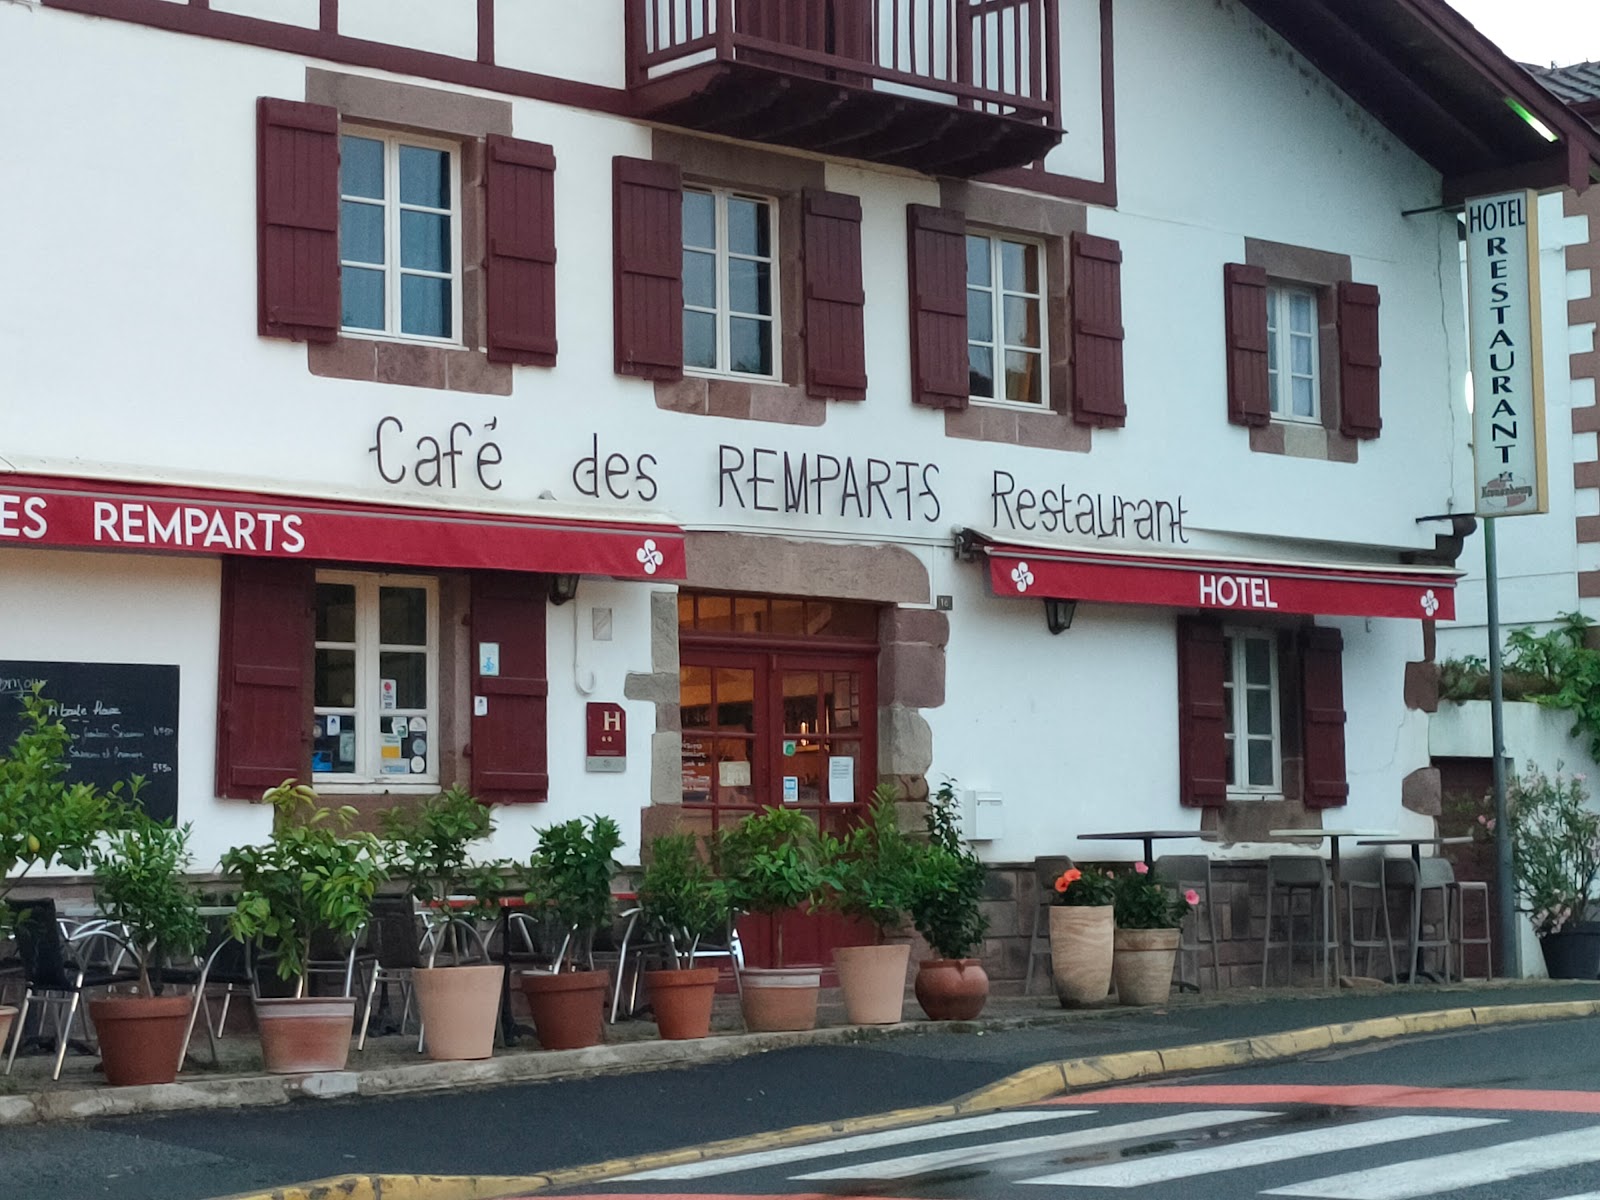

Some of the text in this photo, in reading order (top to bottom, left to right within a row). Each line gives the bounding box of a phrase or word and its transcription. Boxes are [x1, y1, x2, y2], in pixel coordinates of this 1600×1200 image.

[1469, 198, 1525, 233] HOTEL
[1486, 236, 1517, 464] RESTAURANT
[369, 416, 1189, 544] Café des REMPARTS Restaurant
[93, 501, 306, 553] REMPARTS
[1199, 574, 1279, 609] HOTEL
[603, 711, 621, 731] H
